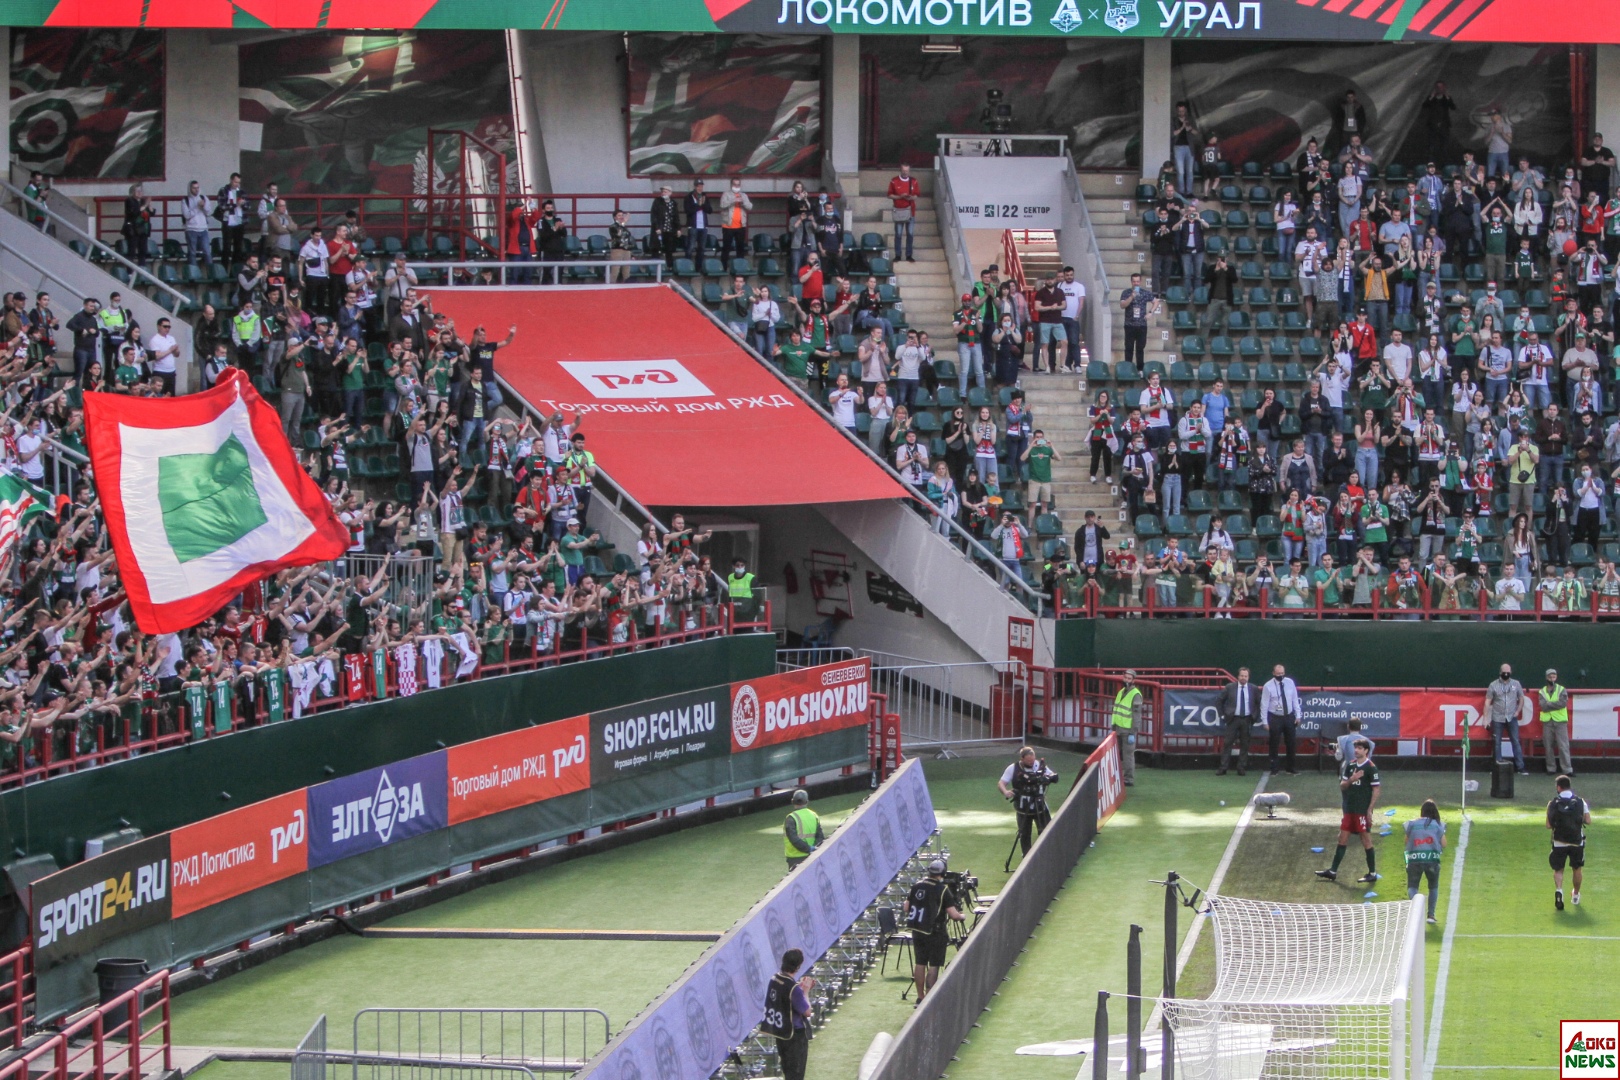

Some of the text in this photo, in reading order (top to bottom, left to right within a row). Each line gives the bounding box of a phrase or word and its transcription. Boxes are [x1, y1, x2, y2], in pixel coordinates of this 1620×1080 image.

[777, 0, 1032, 26] ЛОКОМОТИВ
[1109, 4, 1134, 17] УРАЛ
[1159, 1, 1261, 29] УРАЛ
[1204, 151, 1214, 163] 19
[956, 206, 979, 214] ЫХОД
[1002, 205, 1019, 217] 22
[1023, 206, 1050, 214] СЕКТОР
[540, 394, 795, 415] Торговый дом РЖД
[351, 660, 362, 682] 14
[375, 654, 382, 675] 14
[270, 680, 279, 700] 14
[191, 695, 202, 717] 14
[764, 681, 868, 733] BOLSHOY.RU
[1306, 697, 1341, 707] «РЖД»
[1350, 711, 1392, 721] спонсор
[603, 701, 715, 754] SHOP.FCLM.RU
[451, 753, 546, 800] Торговый дом РЖД
[173, 841, 255, 887] РЖД Логистика
[38, 858, 168, 949] SPORT24.RU
